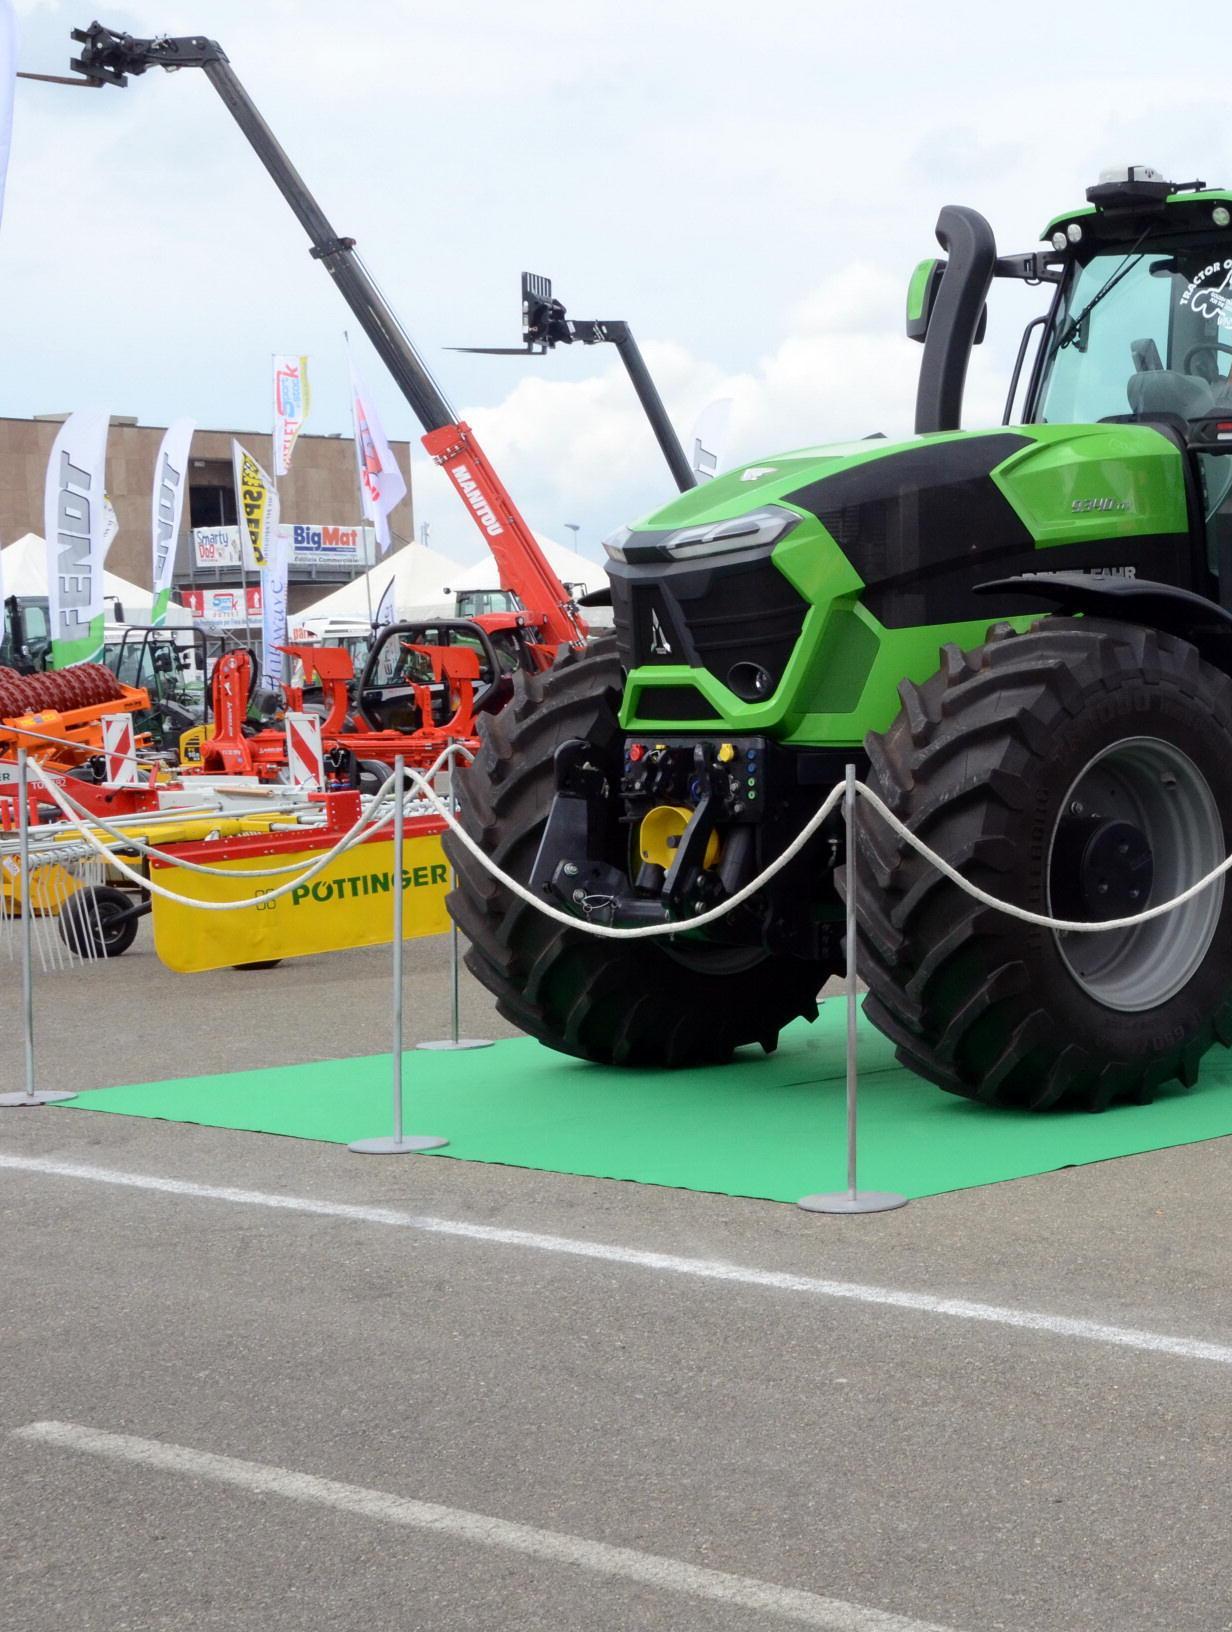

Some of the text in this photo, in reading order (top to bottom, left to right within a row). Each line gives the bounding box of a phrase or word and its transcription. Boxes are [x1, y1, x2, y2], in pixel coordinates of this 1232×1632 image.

[1180, 262, 1220, 305] TRACTOR
[452, 465, 504, 537] MANITOU
[58, 450, 92, 642] FENDT
[197, 531, 229, 547] Smarty
[294, 526, 357, 551] BigMat
